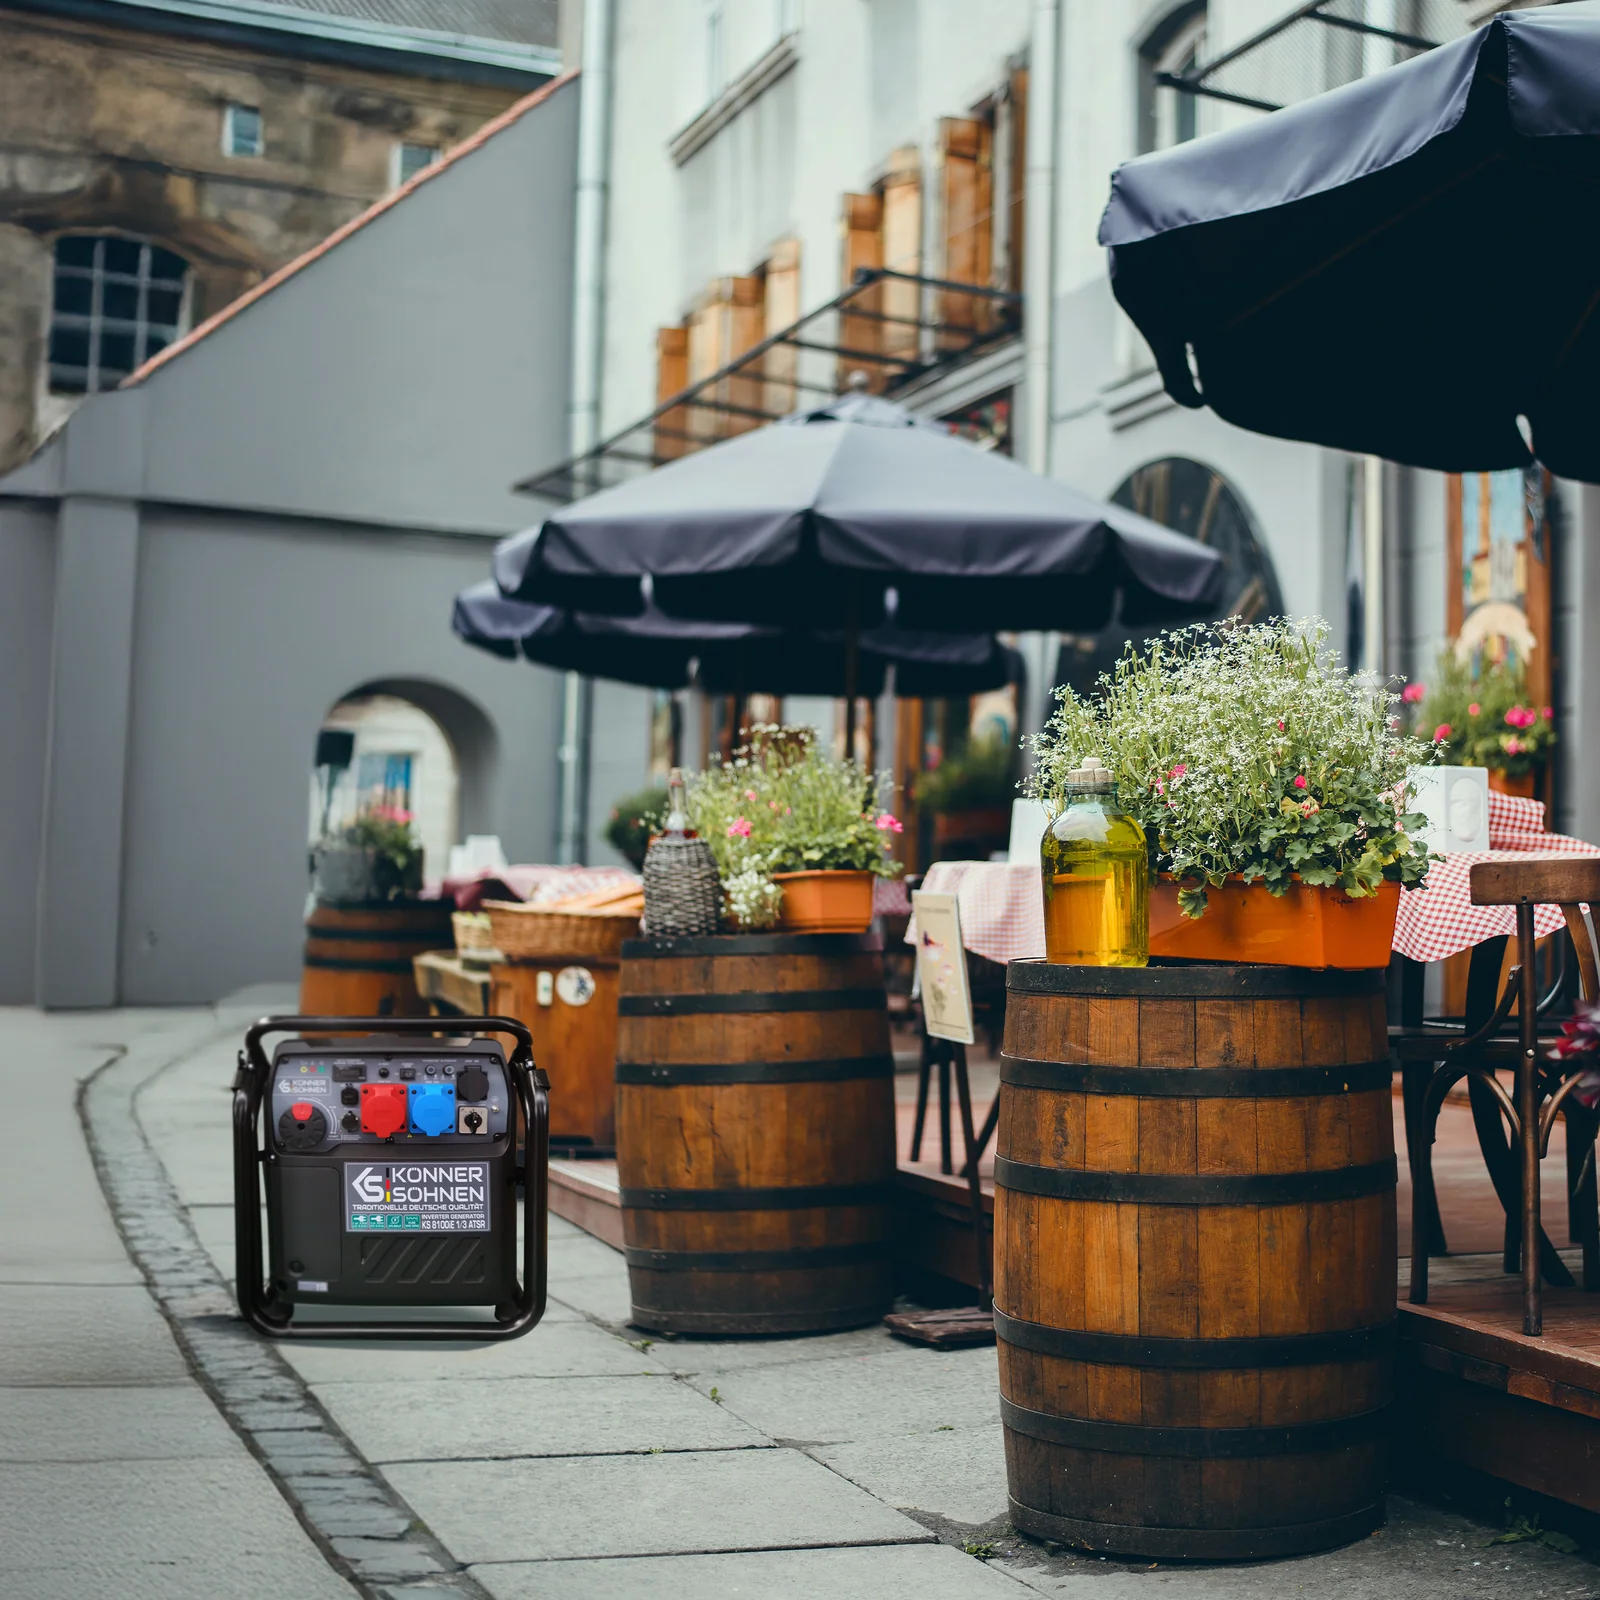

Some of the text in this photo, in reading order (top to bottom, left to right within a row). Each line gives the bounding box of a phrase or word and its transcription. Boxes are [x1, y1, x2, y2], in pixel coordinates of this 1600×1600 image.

[421, 1220, 431, 1229] KS
[456, 1220, 467, 1229] 1/3
[468, 1219, 486, 1229] ATSR
